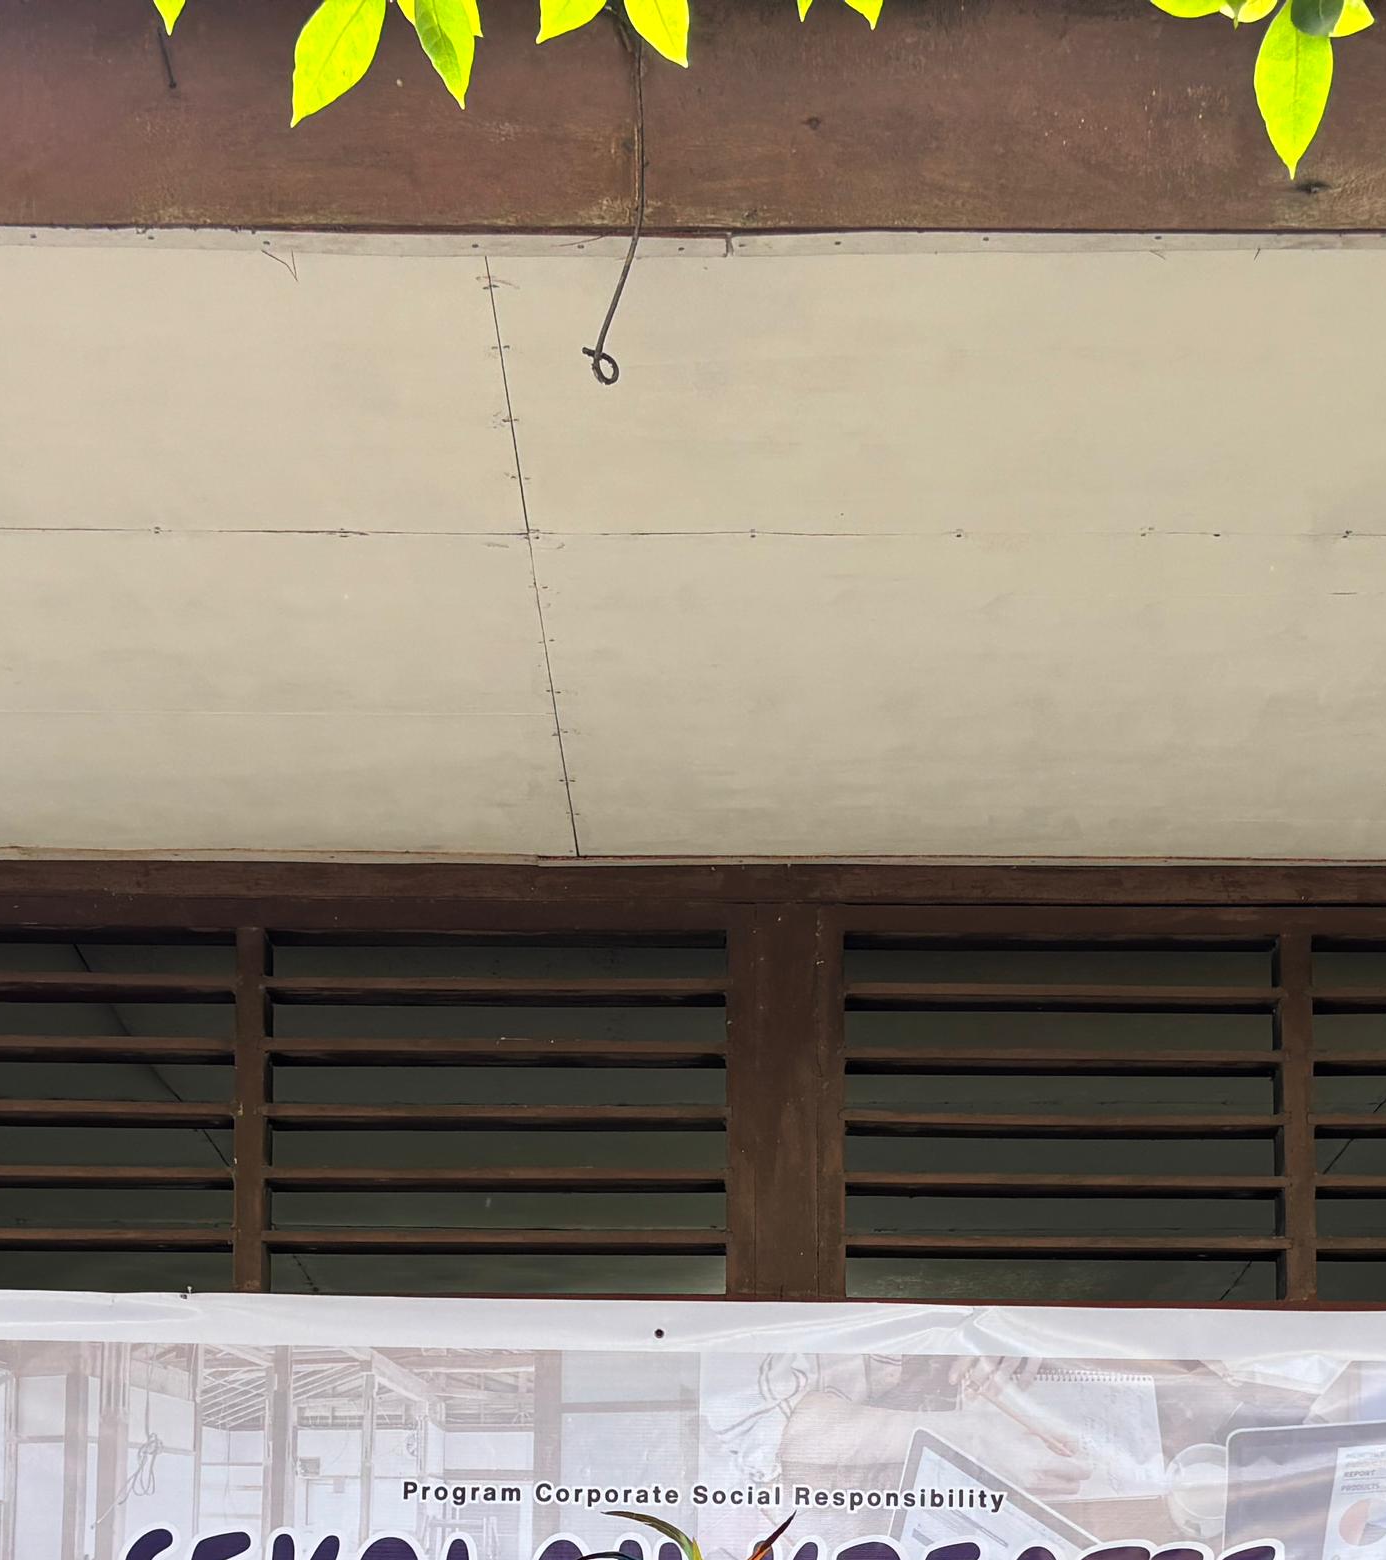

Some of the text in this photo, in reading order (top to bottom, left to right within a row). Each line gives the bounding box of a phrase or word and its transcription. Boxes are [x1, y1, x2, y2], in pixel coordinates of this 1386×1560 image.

[403, 1481, 1006, 1513] Program Corporate Social Responsibility
